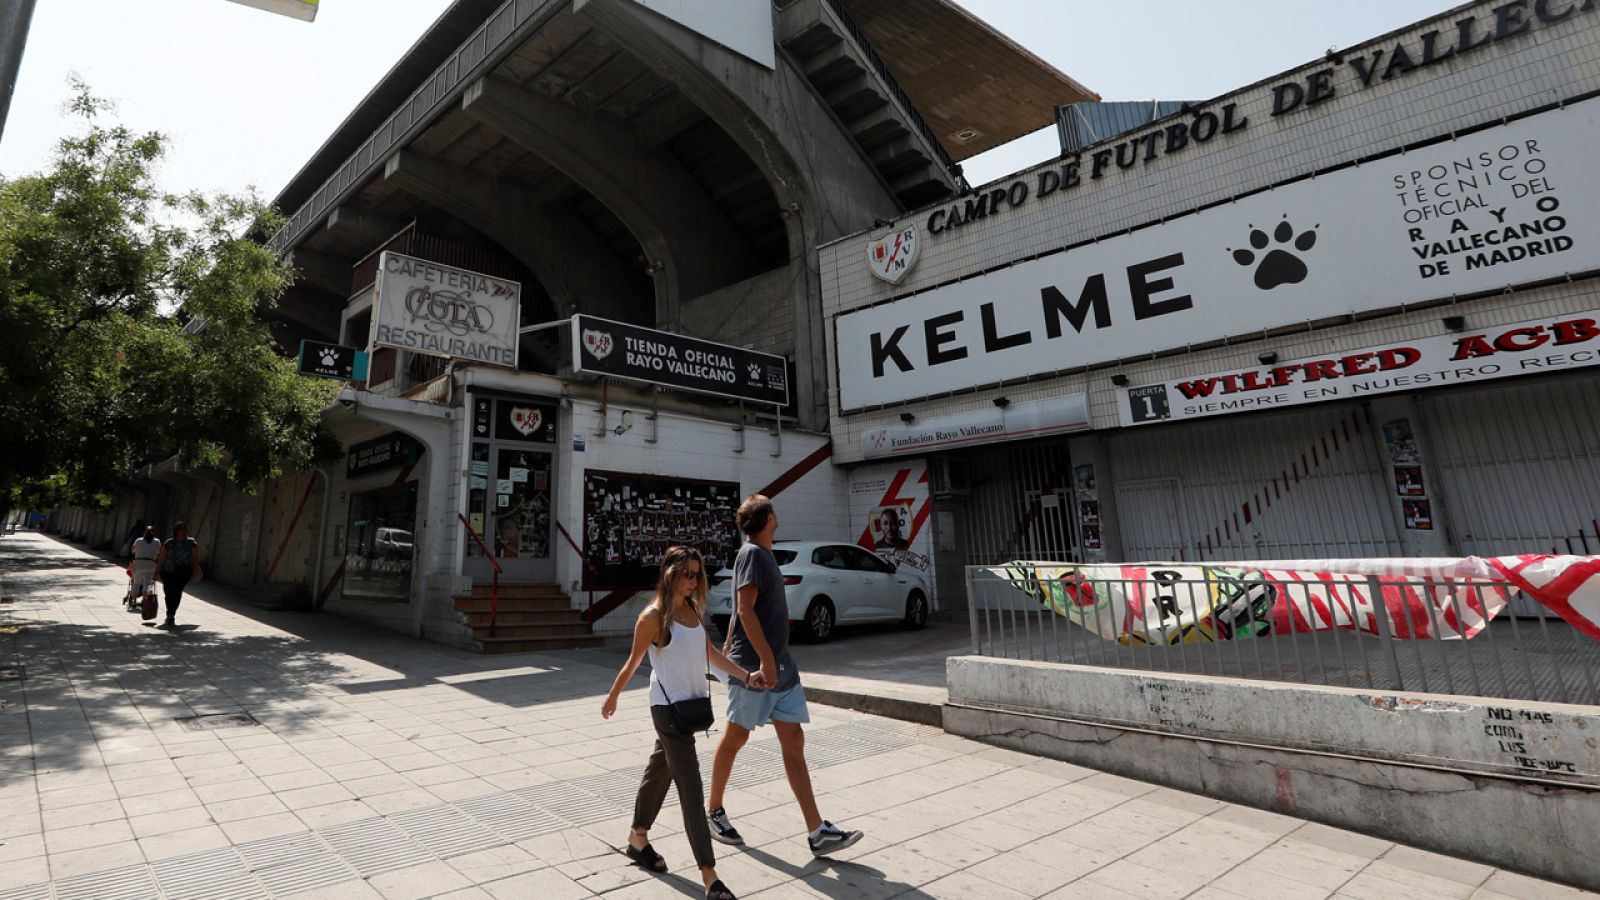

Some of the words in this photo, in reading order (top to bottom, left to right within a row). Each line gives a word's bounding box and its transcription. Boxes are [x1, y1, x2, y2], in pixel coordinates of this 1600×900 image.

[927, 180, 1028, 235] CAMPO
[1036, 160, 1082, 198] DE
[1090, 102, 1247, 180] FUTBOL
[1270, 67, 1335, 116] DE
[1348, 0, 1600, 86] VALLEC
[1393, 139, 1541, 190] SPONSOR
[1396, 158, 1546, 206] TÉCNICO
[1403, 193, 1489, 224] OFICIAL
[1511, 176, 1555, 199] DEL
[1408, 196, 1559, 242] RAYO
[1412, 215, 1567, 260] VALLECANO
[1419, 260, 1450, 279] DE
[1465, 235, 1574, 271] MADRID
[385, 257, 488, 295] CAFETERIA
[870, 252, 1193, 378] KELME
[377, 325, 515, 364] RESTAURANTE
[624, 336, 677, 359] TIENDA
[684, 349, 736, 370] OFICIAL
[626, 351, 664, 371] RAYO
[666, 360, 736, 384] VALLECANO
[1174, 346, 1421, 400] WILFRED
[1184, 393, 1289, 415] SIEMPRE
[1303, 386, 1338, 399] EN
[1353, 364, 1501, 393] NUESTRO
[1520, 350, 1600, 369] REC
[1130, 386, 1165, 398] PUERTA
[1142, 396, 1156, 418] 1
[891, 433, 933, 447] Fundación
[935, 430, 958, 441] Rayo
[959, 423, 1003, 437] Vallecano
